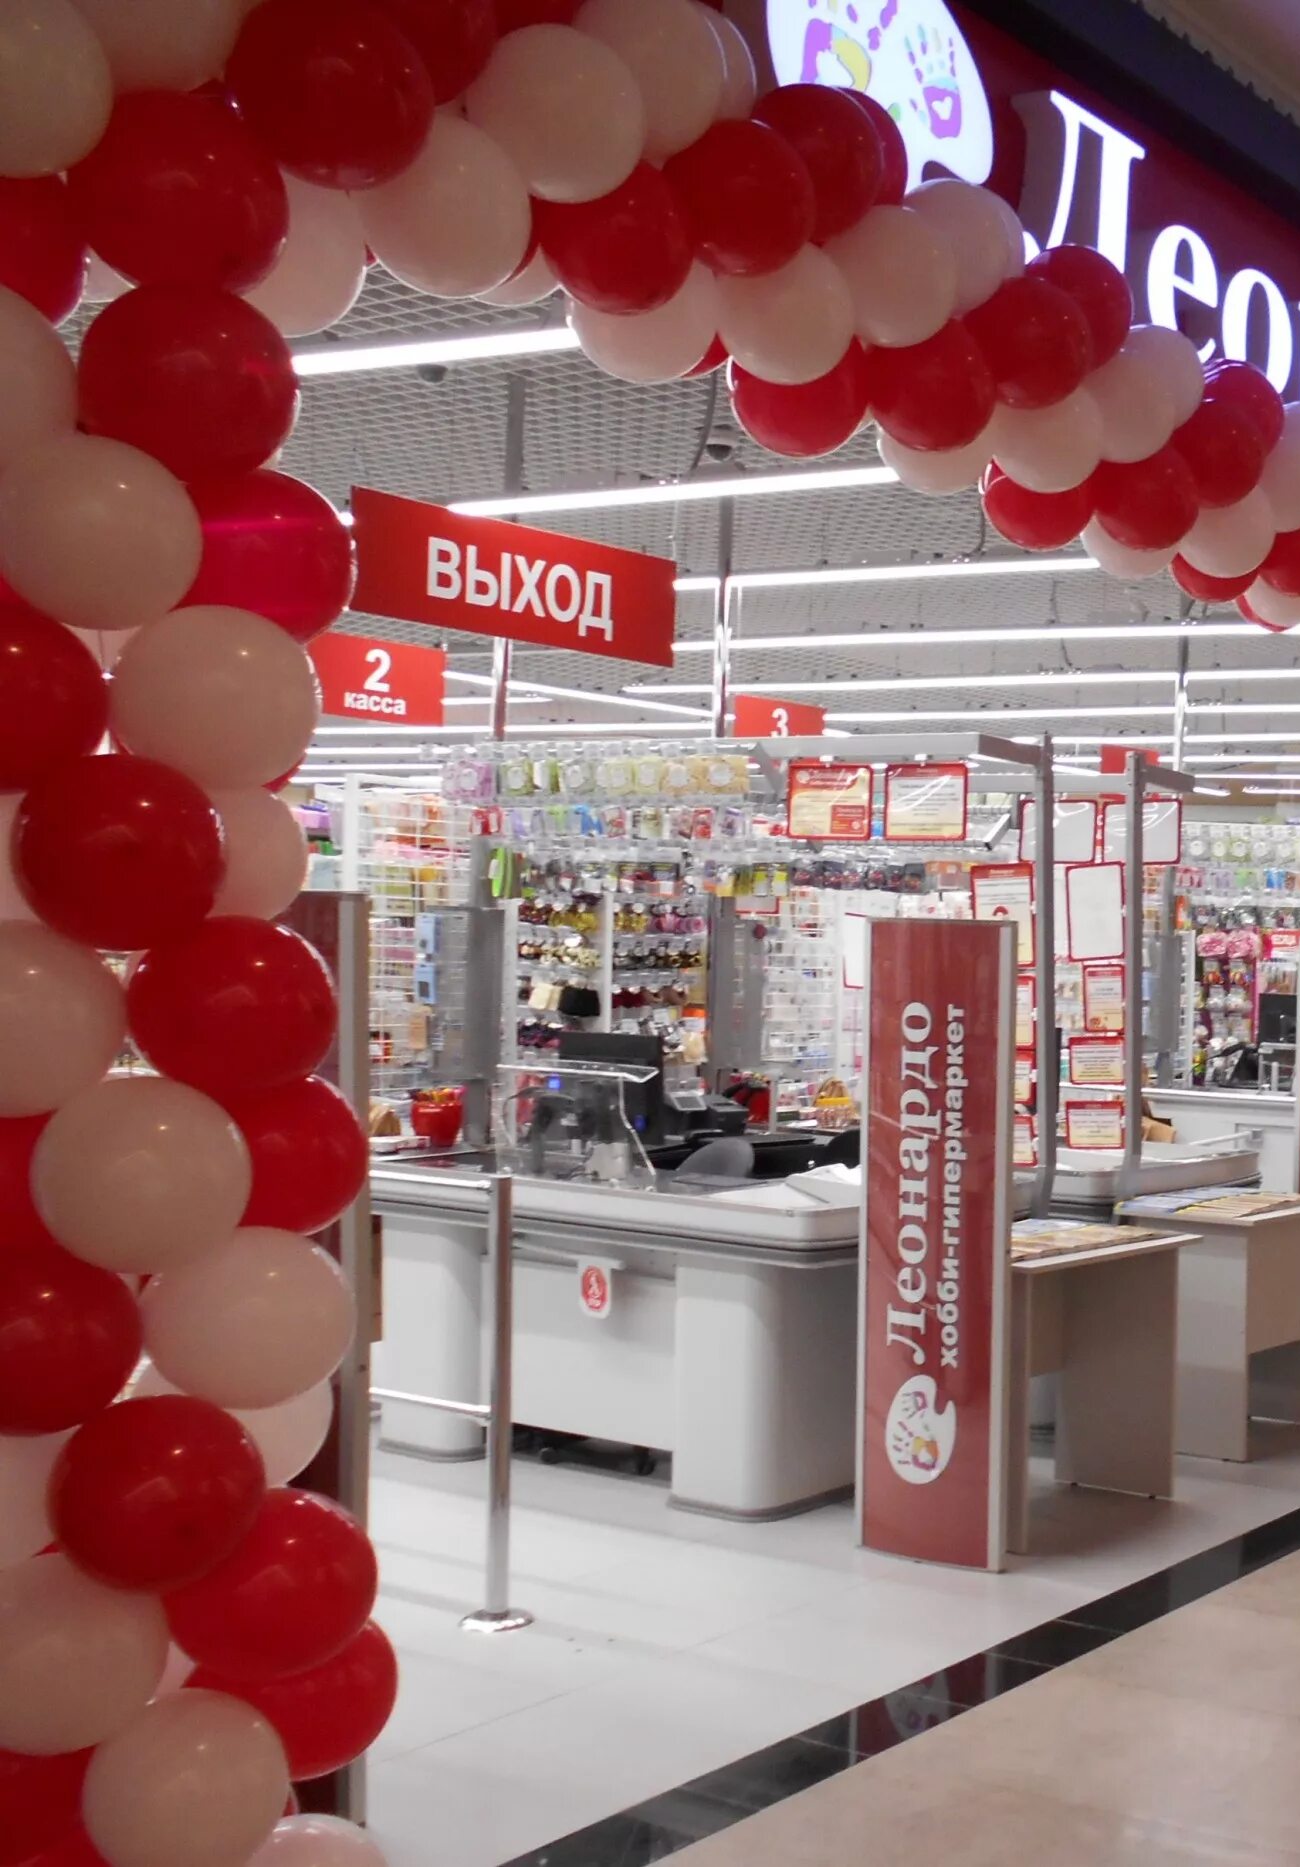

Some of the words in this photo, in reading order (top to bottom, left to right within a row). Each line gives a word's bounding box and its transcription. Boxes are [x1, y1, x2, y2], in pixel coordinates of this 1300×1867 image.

[426, 535, 614, 642] ВЫХОД
[344, 691, 407, 715] касса
[363, 648, 391, 693] 2
[770, 707, 789, 737] 3
[886, 1001, 942, 1366] Леонардо
[936, 1003, 969, 1369] хобби-гипермаркет
